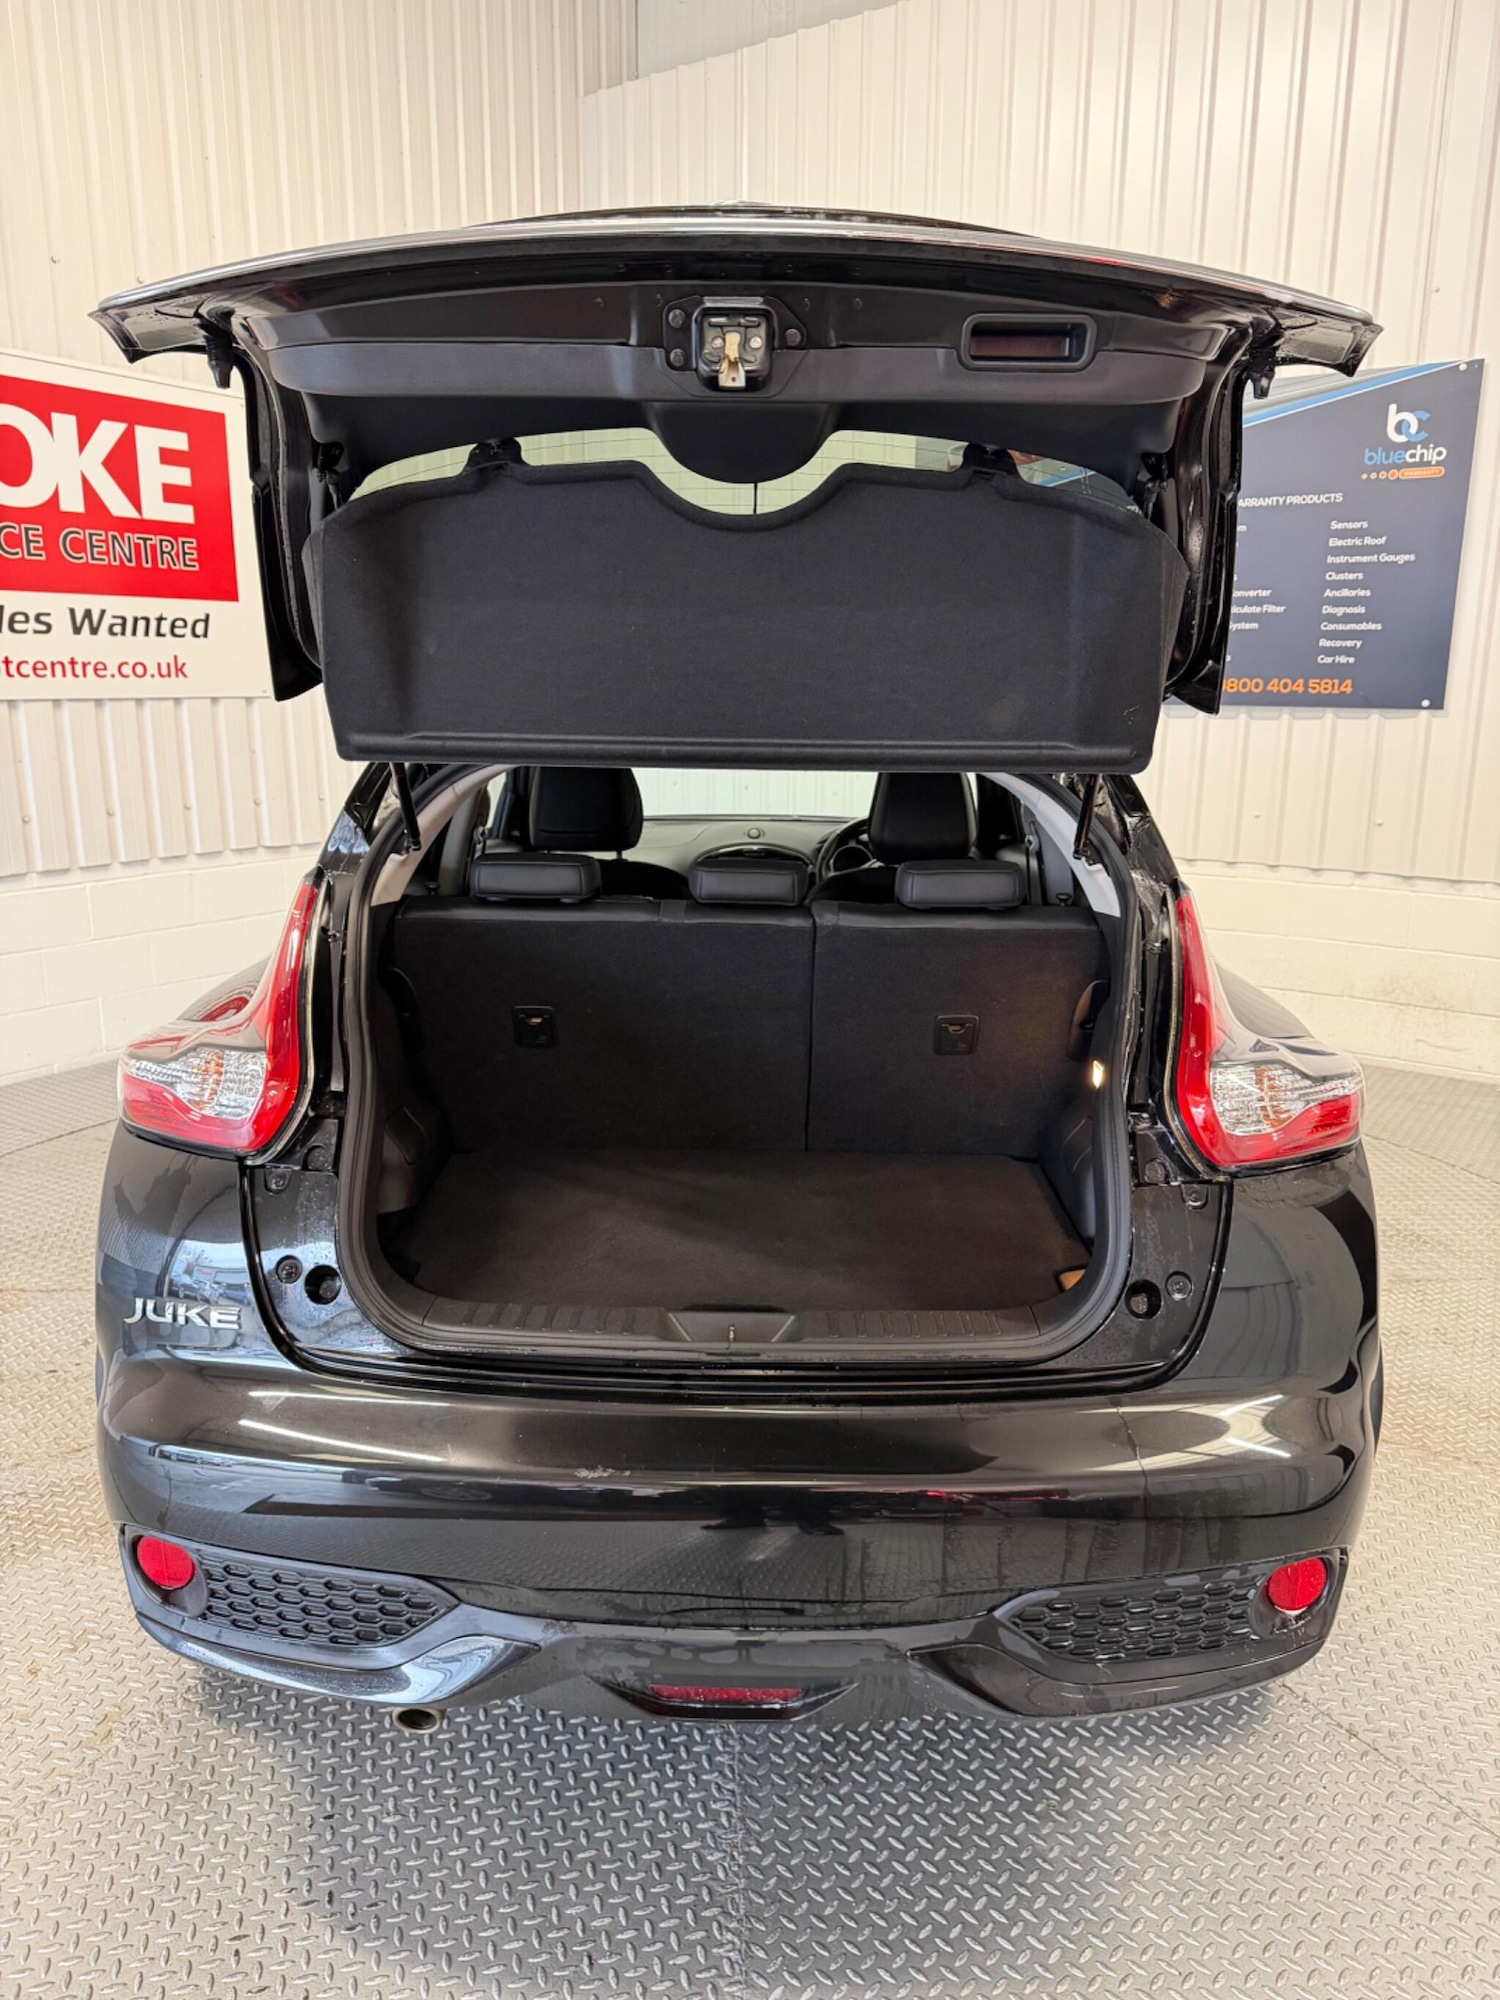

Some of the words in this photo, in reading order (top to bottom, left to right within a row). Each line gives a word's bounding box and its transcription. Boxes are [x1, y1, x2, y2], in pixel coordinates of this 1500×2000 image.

[1364, 443, 1447, 465] bluechip
[0, 403, 196, 524] OKE
[1286, 492, 1343, 505] PRODUCTS
[1329, 520, 1368, 530] Sensors
[1328, 537, 1363, 547] Electric
[1363, 535, 1387, 546] Roof
[59, 527, 199, 571] CENTRE
[1326, 553, 1378, 564] Instrument
[1379, 552, 1416, 564] Gauges
[1325, 571, 1364, 581] Clusters
[1323, 588, 1371, 598] Ancillaries
[1262, 603, 1287, 614] Filter
[1322, 605, 1366, 617] Diagnosis
[68, 607, 210, 639] Wanted
[1320, 621, 1383, 631] Consumables
[1318, 638, 1363, 650] Recovery
[1317, 655, 1334, 664] Car
[1334, 655, 1356, 664] Hire
[0, 654, 188, 680] tcentre.co.uk
[1266, 677, 1304, 694] 404
[1307, 678, 1353, 695] 5814
[123, 1297, 241, 1330] JUKE
